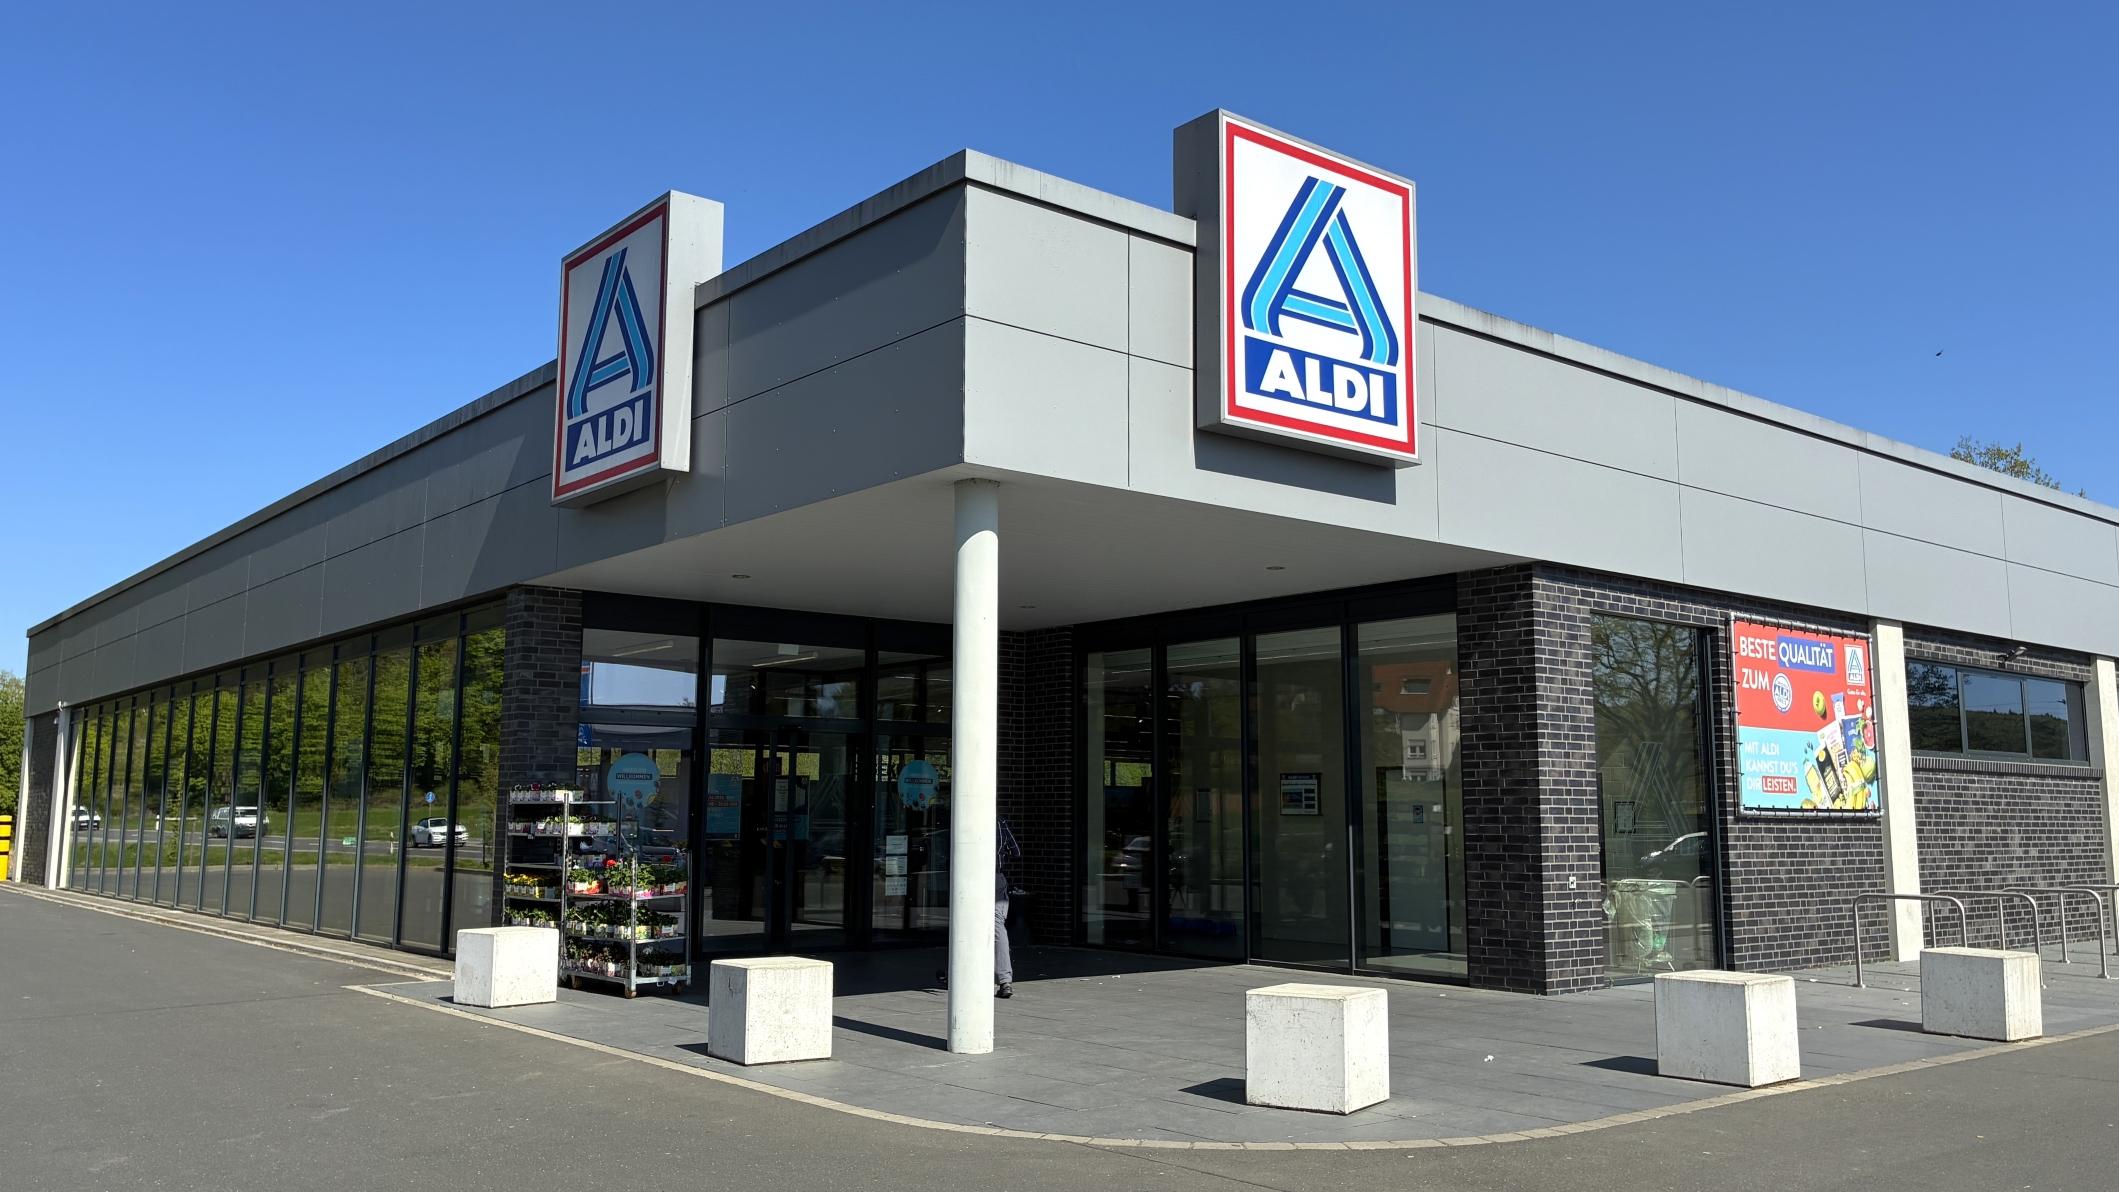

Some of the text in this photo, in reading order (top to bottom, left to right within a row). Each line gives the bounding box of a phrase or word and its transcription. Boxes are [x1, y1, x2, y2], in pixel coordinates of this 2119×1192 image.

[1259, 348, 1386, 418] ALDI
[572, 398, 644, 466] ALDI
[1739, 635, 1833, 668] BESTE QUALITÄT
[1741, 667, 1771, 691] ZUM
[1744, 741, 1780, 756] MIT ALDI
[1745, 759, 1799, 774] KANNST DU'S
[1746, 777, 1797, 792] DIR LEISTEN.
